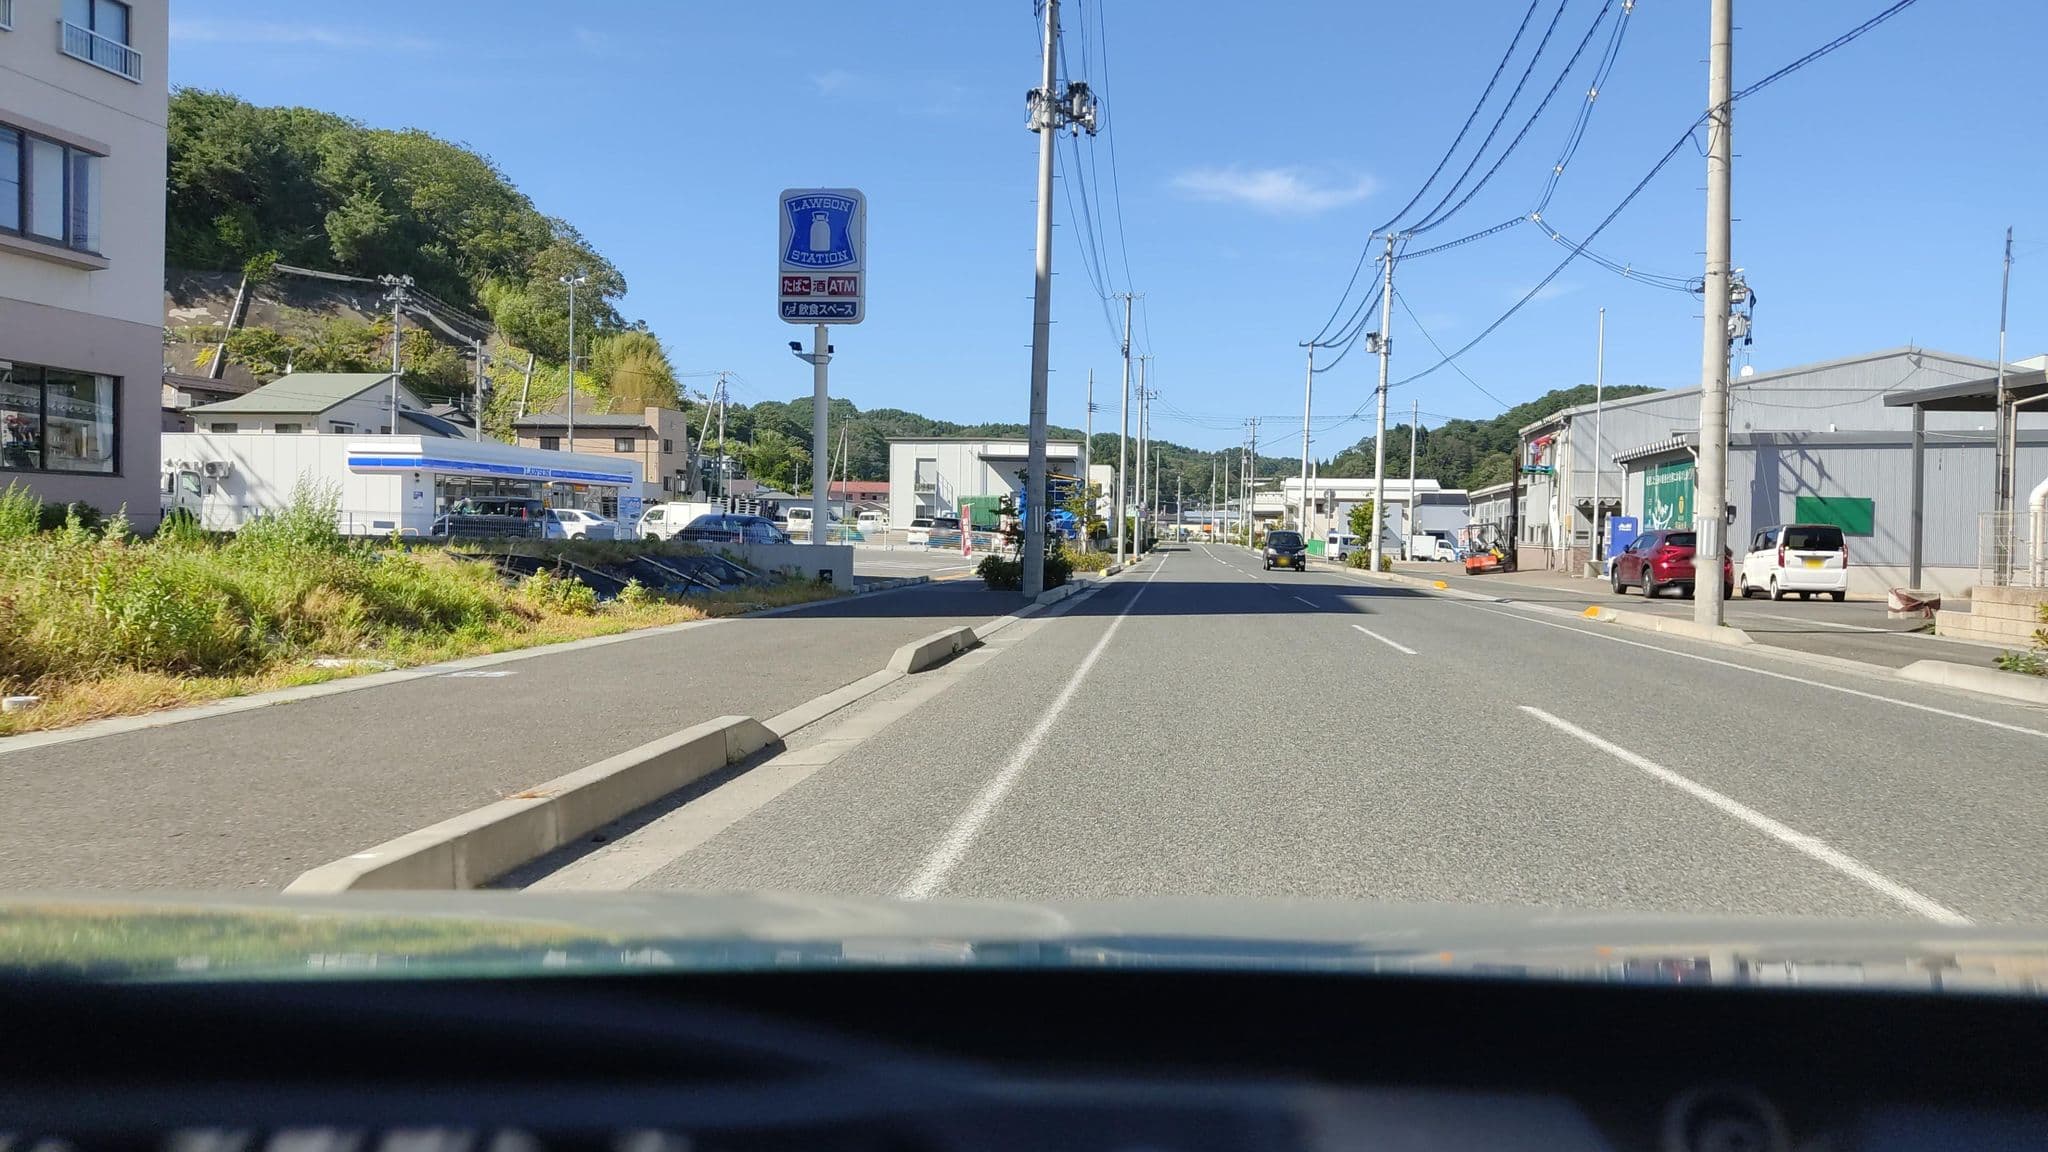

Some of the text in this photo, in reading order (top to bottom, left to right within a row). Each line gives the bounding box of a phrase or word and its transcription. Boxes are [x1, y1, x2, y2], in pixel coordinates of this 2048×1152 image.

[791, 198, 851, 212] LAWSON
[791, 250, 849, 264] STATION
[783, 279, 810, 293] たばこ
[829, 280, 855, 292] ATM
[798, 303, 854, 316] 飲食スペース
